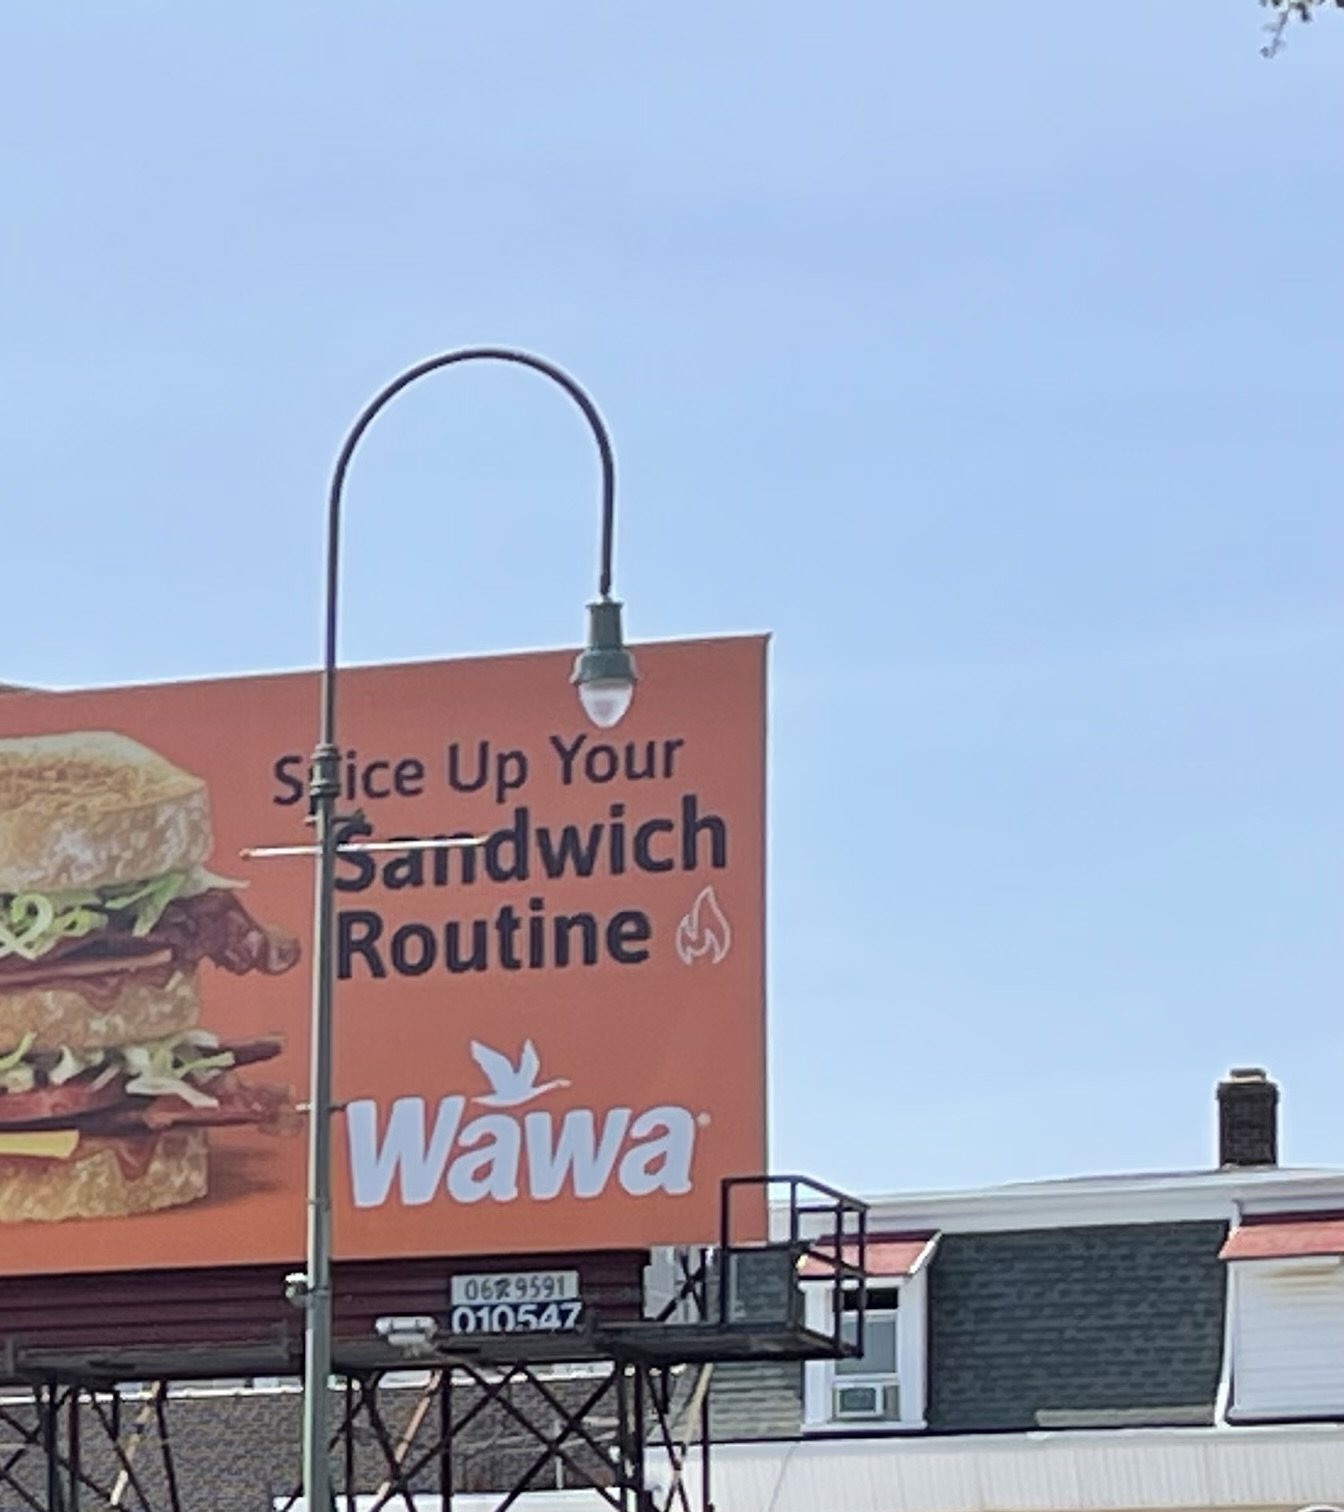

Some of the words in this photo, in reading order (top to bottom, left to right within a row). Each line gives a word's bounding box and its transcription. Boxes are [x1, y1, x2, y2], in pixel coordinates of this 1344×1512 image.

[273, 750, 425, 816] Sice
[448, 741, 528, 803] Up
[549, 733, 683, 786] Your
[333, 795, 727, 892] Sandwich
[336, 897, 651, 980] Routine
[346, 1094, 697, 1209] Wawa
[451, 1301, 582, 1334] 010547
